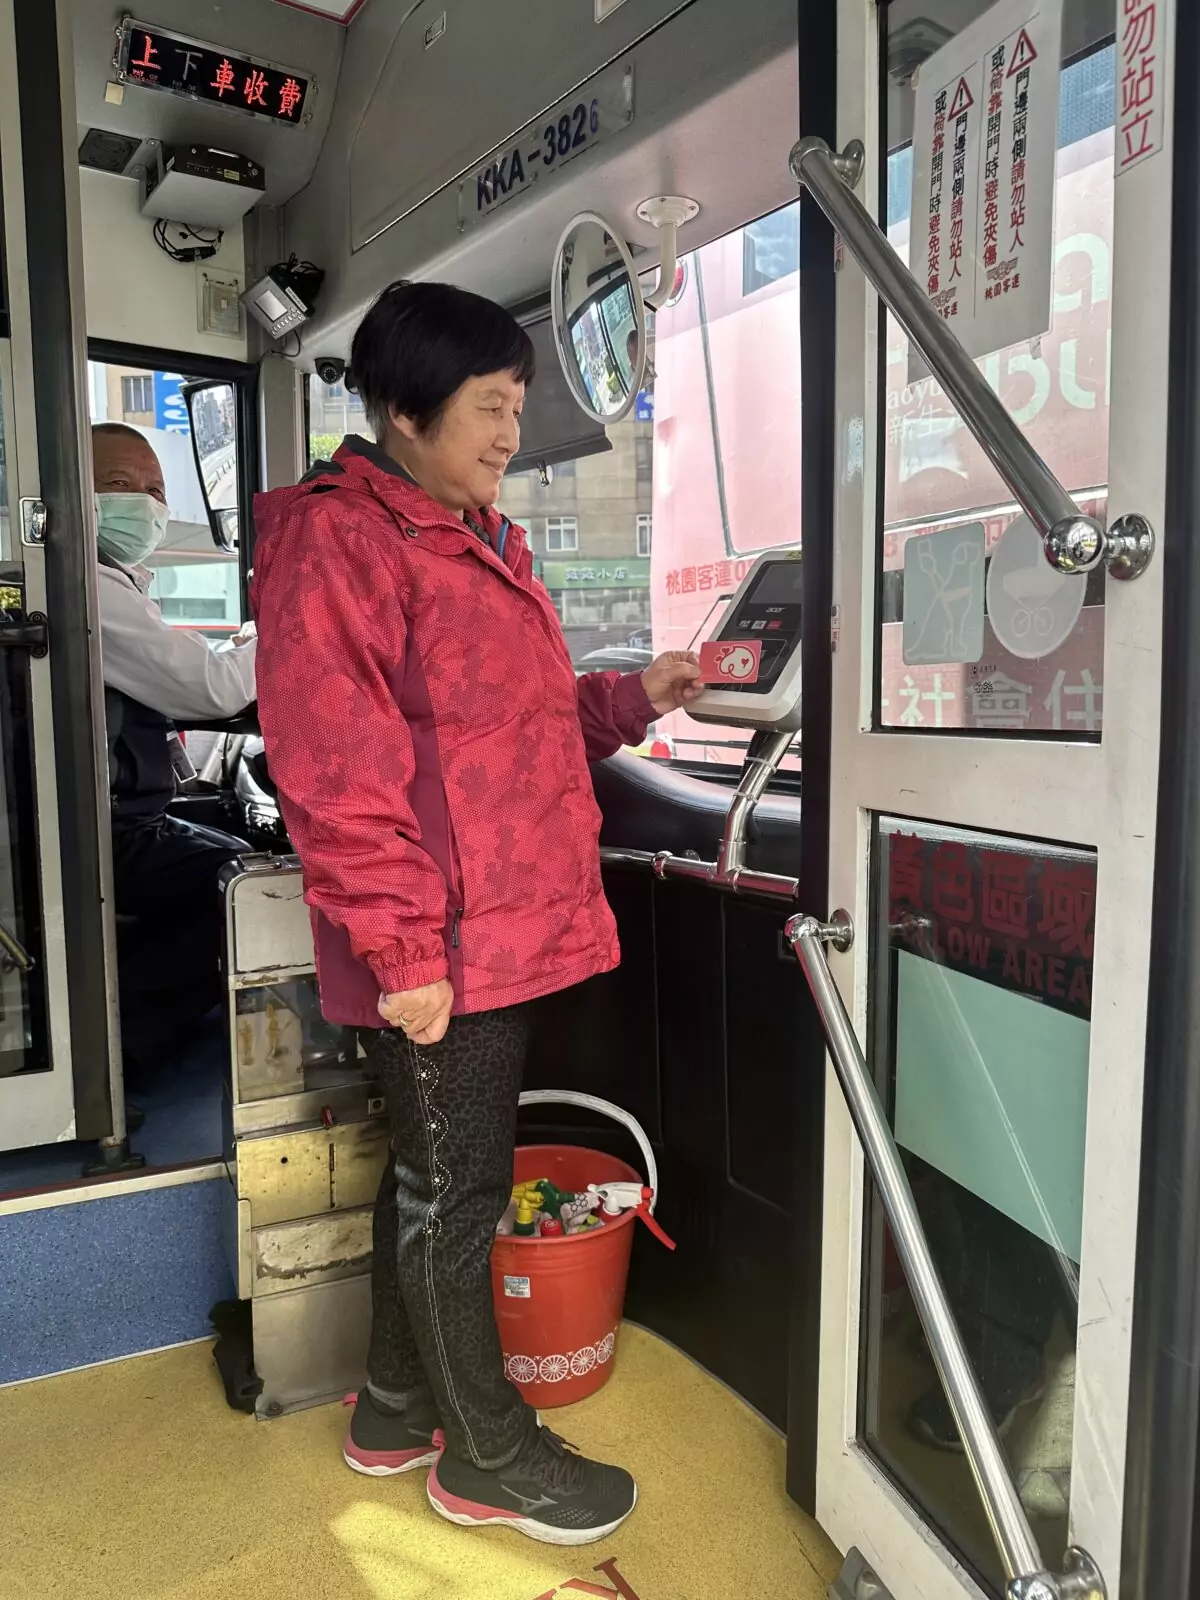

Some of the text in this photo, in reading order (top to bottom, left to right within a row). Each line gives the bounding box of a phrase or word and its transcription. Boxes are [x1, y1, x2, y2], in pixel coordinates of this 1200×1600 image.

[131, 35, 302, 118] 上下車收費
[478, 99, 599, 211] KKA-3826
[927, 91, 947, 296] 或倚靠開門時避免夾傷
[949, 112, 968, 282] 門邊兩側請勿站人
[983, 44, 1005, 268] 或倚靠開門時避免夾傷
[1009, 66, 1030, 253] 門邊兩側請勿站人
[985, 273, 1020, 300] 桃園客運
[882, 668, 1103, 729] 社會住
[1003, 945, 1091, 1008] AREA
